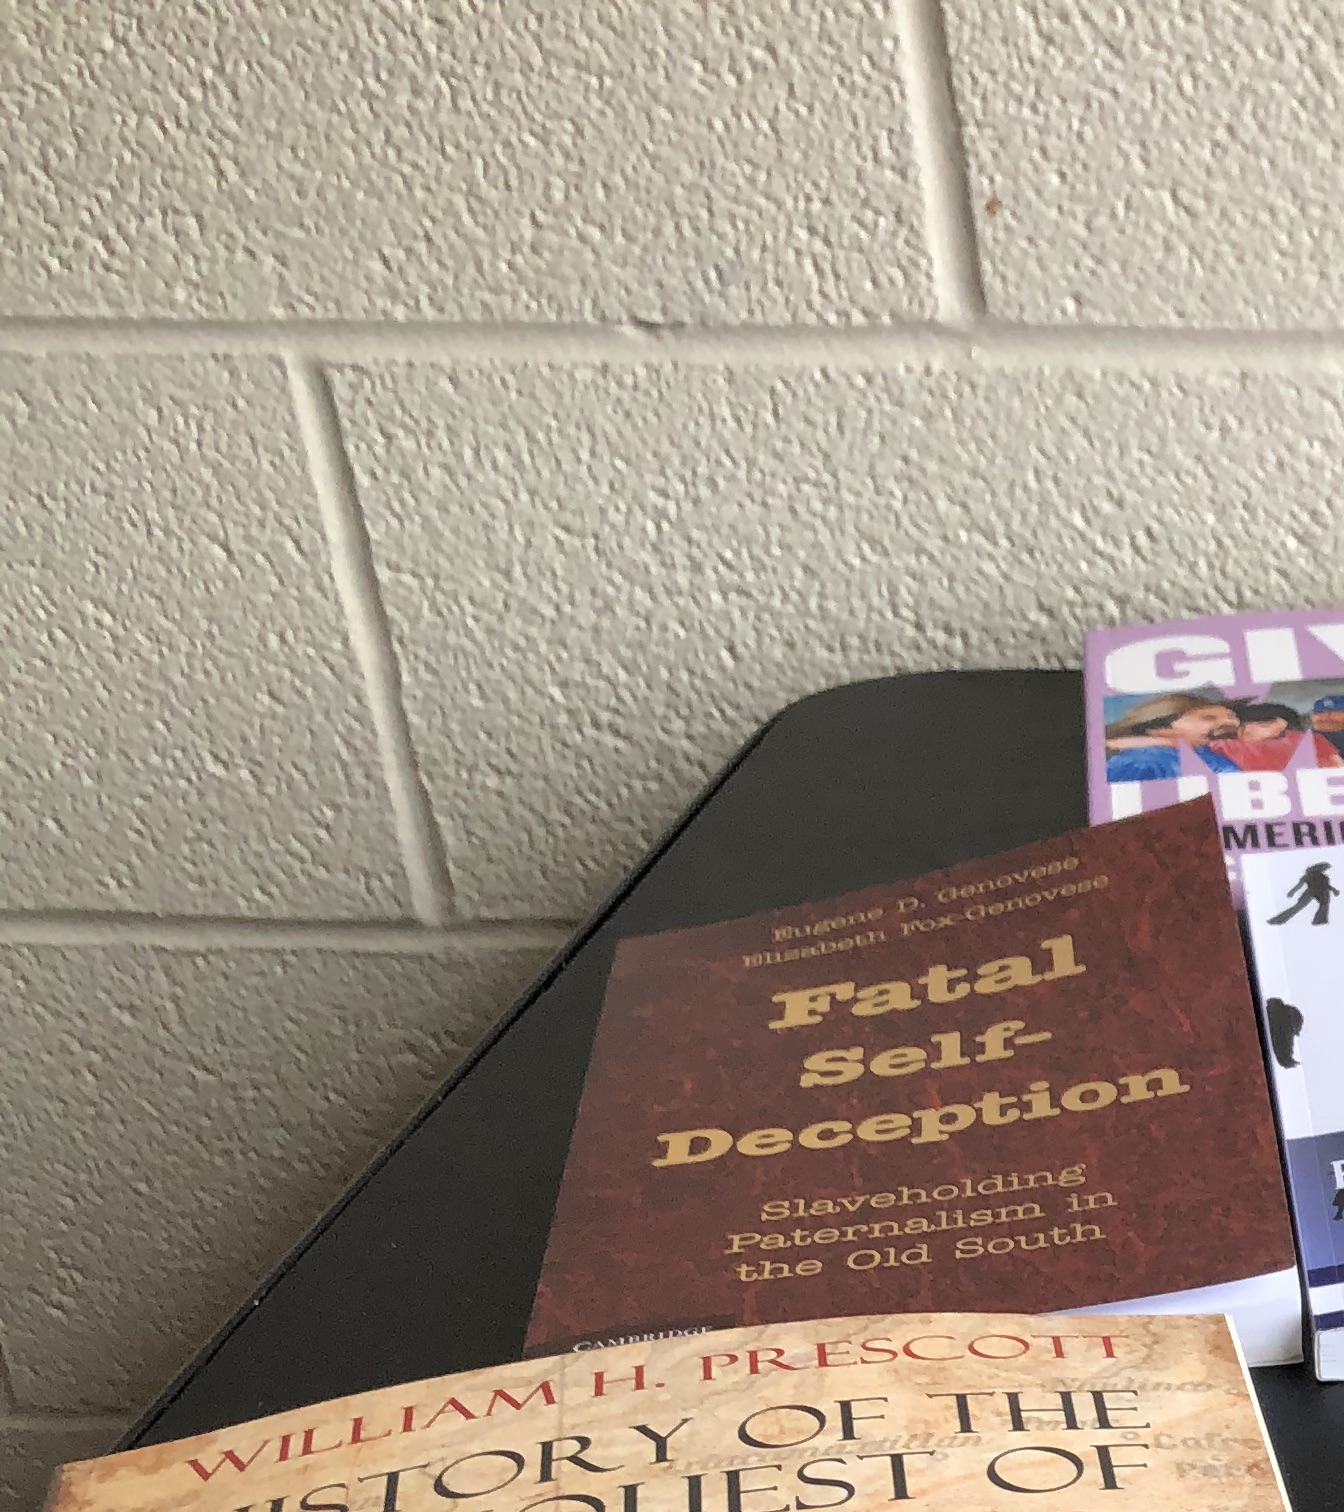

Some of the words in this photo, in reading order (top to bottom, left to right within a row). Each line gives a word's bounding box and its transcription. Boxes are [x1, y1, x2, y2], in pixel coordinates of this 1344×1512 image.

[742, 928, 889, 971] Elizabeth
[900, 873, 1110, 940] Fox-Genovese
[770, 903, 885, 944] Eugene
[894, 891, 927, 918] D.
[937, 852, 1081, 908] Genovese
[766, 934, 1088, 1034] Fatal
[798, 1018, 1053, 1091] Self-
[650, 1063, 1191, 1170] Deception
[722, 1198, 1044, 1257] Paternalism
[1068, 1184, 1120, 1213] in
[759, 1161, 1088, 1224] Slaveholding
[735, 1252, 825, 1285] the
[845, 1242, 932, 1273] Old
[955, 1217, 1108, 1260] South
[187, 1380, 557, 1483] WILLIAM
[592, 1364, 666, 1397] H.
[700, 1334, 1131, 1382] PRESCOTT
[737, 1396, 890, 1449] OF
[926, 1389, 1152, 1434] THE
[986, 1443, 1150, 1494] OF
